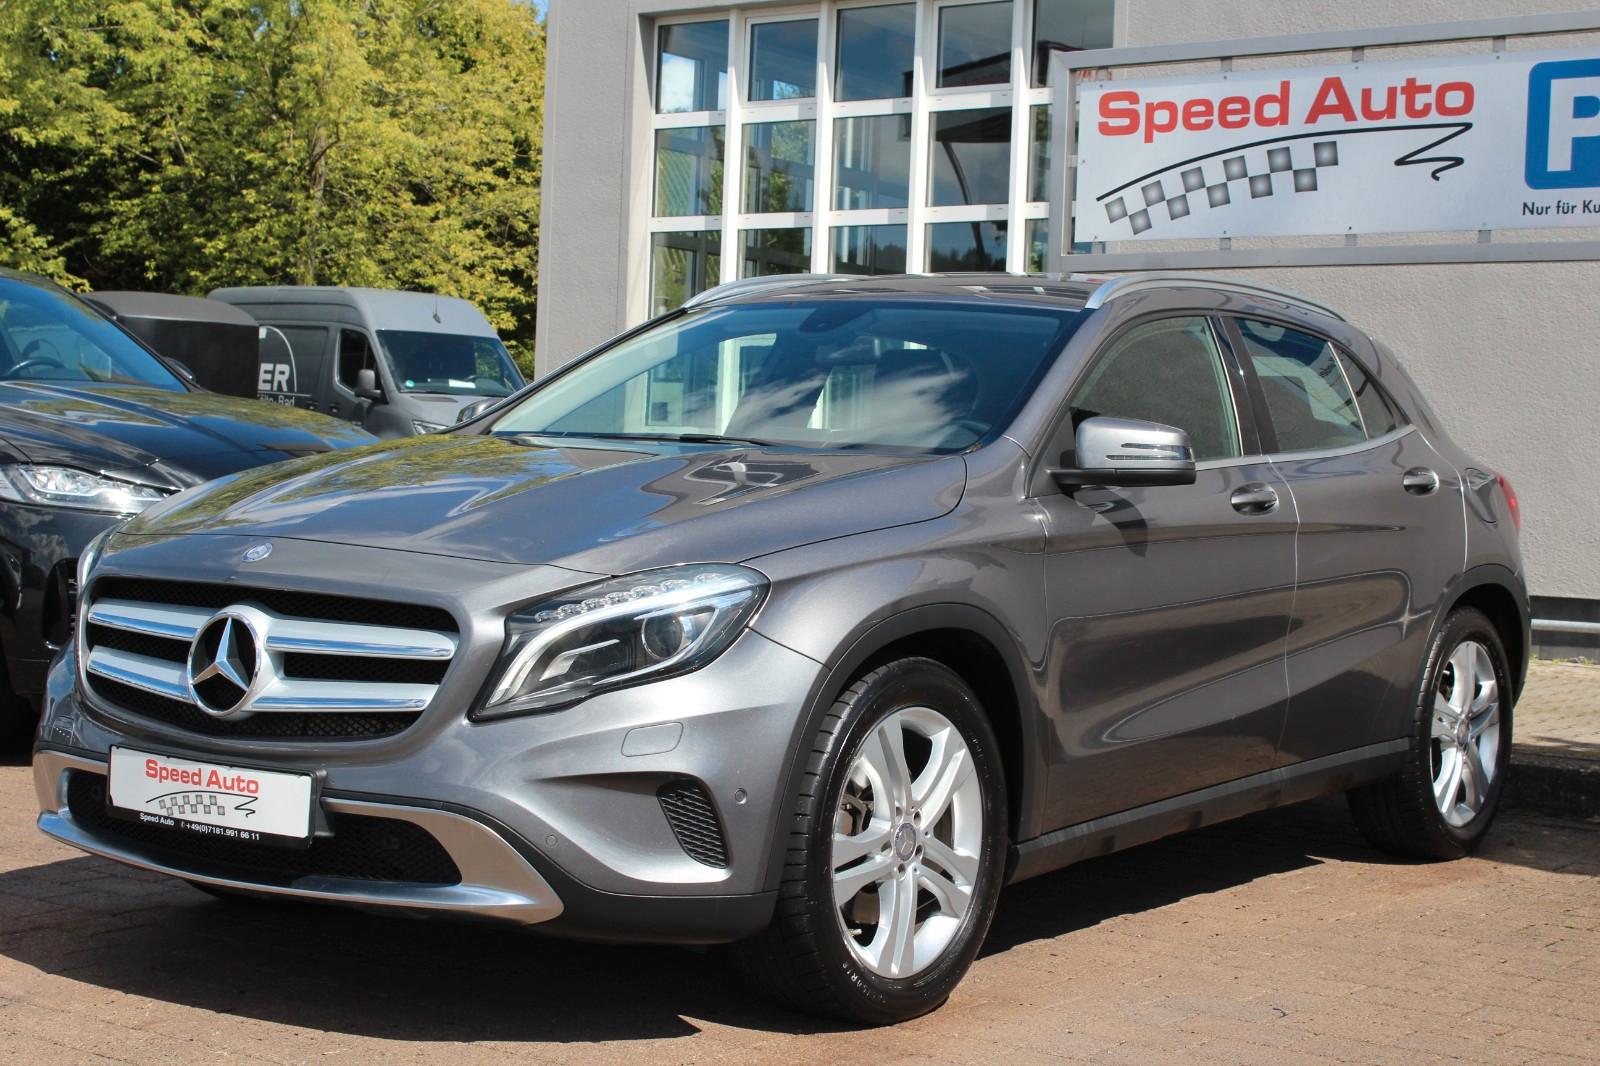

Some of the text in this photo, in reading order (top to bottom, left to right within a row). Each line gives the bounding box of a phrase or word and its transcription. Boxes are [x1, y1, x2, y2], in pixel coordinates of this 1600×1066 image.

[1098, 76, 1475, 144] Speed Auto
[1546, 76, 1600, 172] P
[1522, 201, 1551, 216] Nur
[1556, 199, 1577, 215] für
[145, 758, 259, 794] Speed Auto
[139, 812, 159, 823] Speed
[160, 816, 175, 826] Auto
[251, 833, 260, 841] 11
